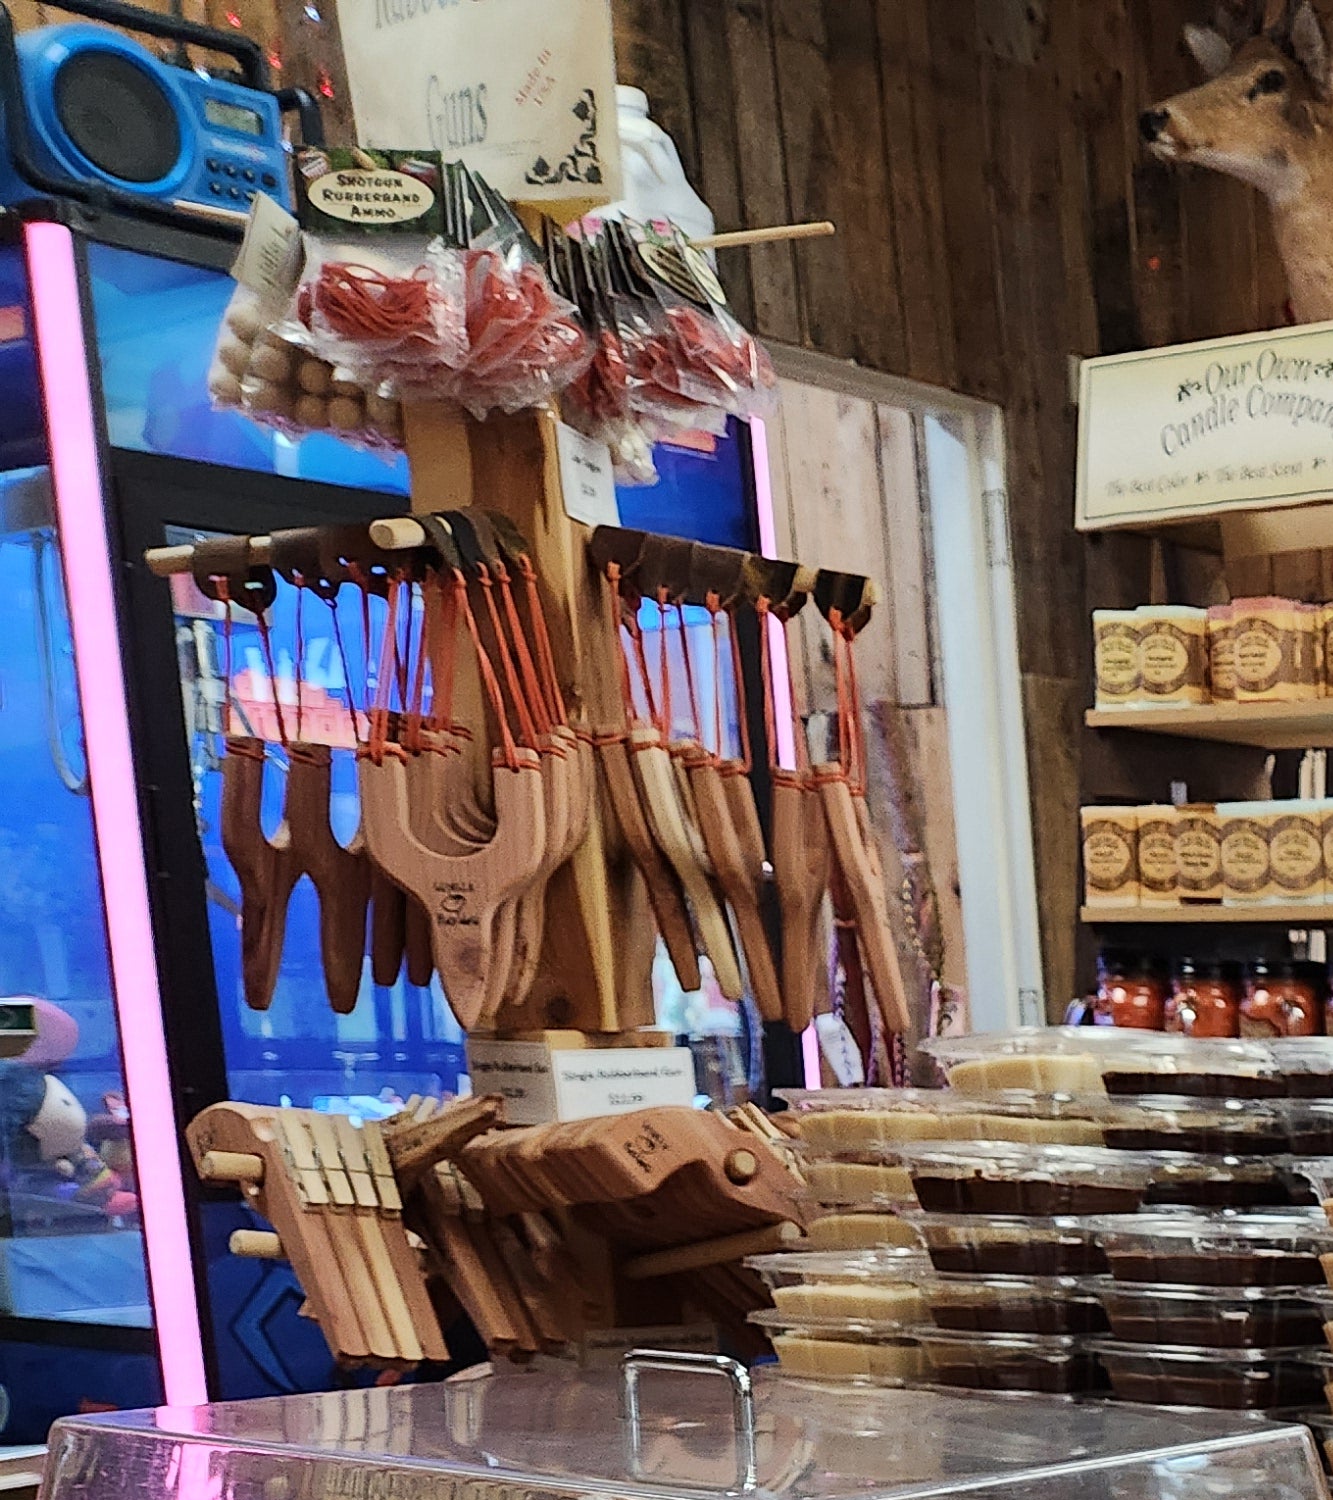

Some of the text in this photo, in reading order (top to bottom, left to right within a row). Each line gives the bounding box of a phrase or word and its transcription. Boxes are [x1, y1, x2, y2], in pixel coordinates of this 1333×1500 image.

[426, 73, 488, 150] Guns
[350, 205, 396, 219] AMMO
[1205, 349, 1312, 395] Our Own
[1160, 395, 1240, 457] Candle
